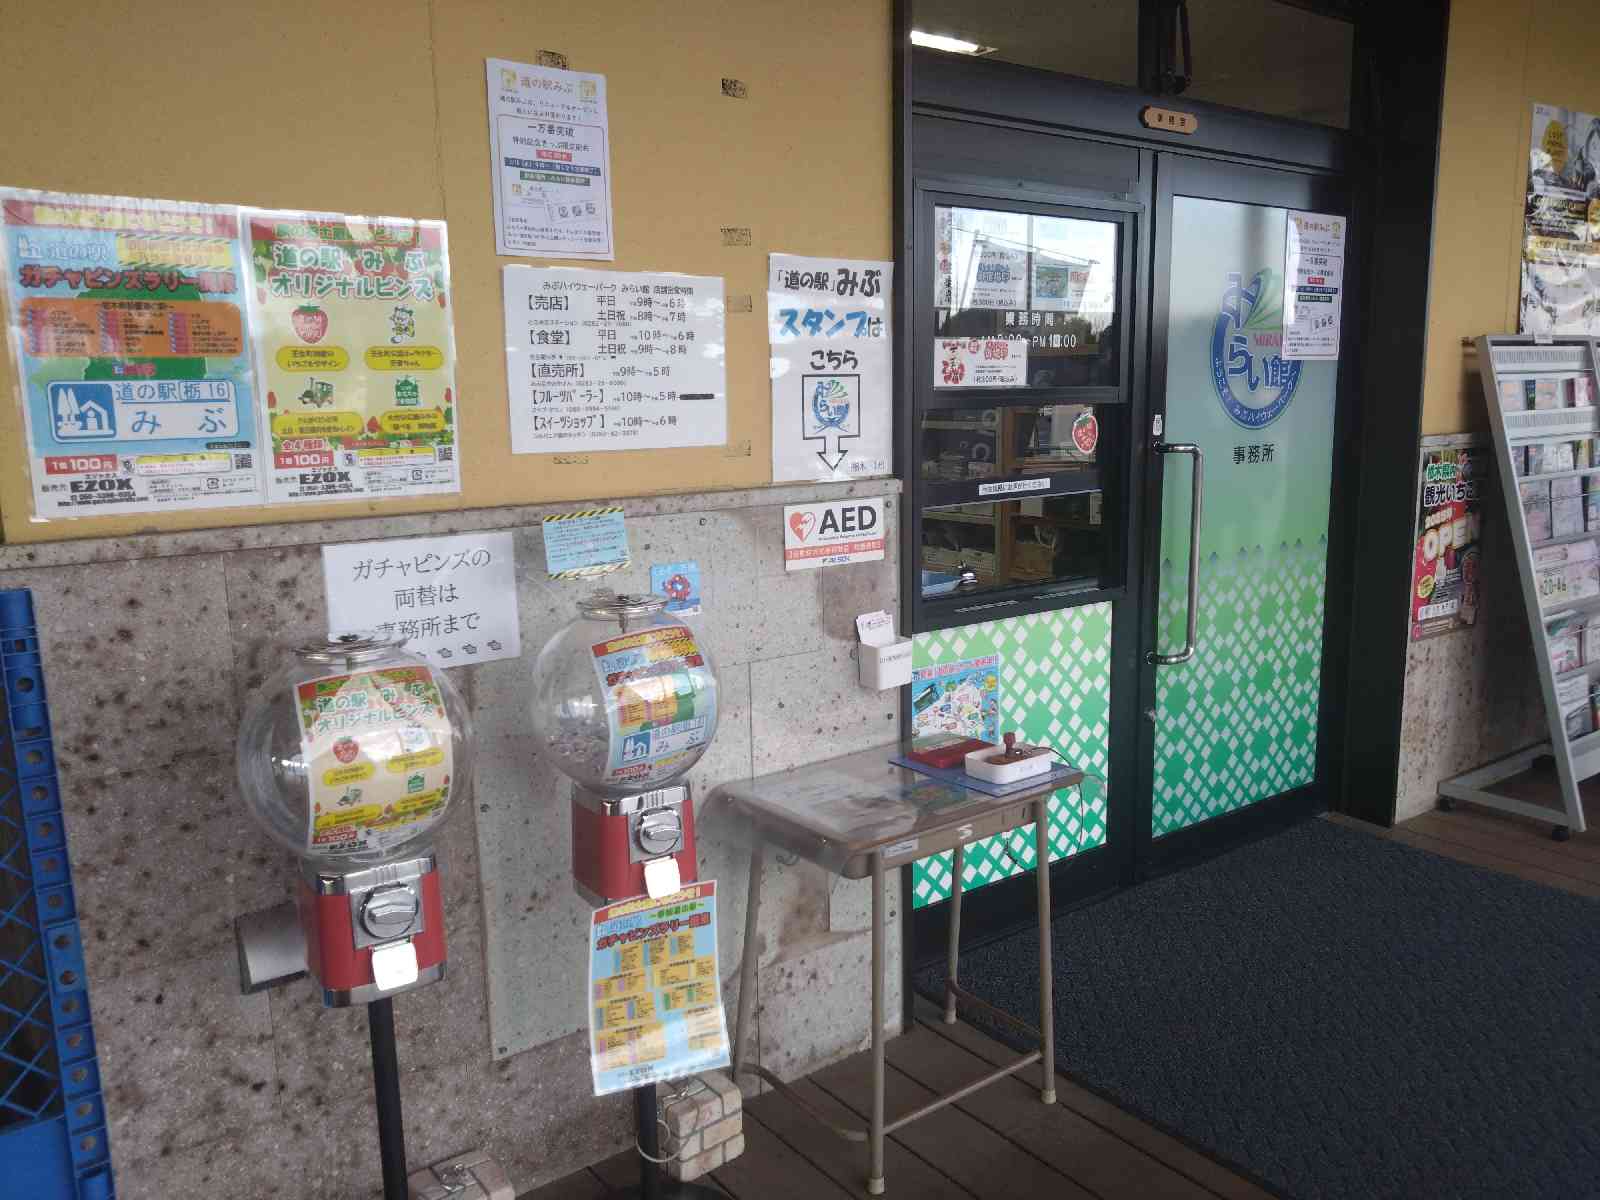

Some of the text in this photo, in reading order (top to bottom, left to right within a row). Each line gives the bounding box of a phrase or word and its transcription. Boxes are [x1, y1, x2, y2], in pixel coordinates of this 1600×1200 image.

[596, 296, 616, 307] 平日
[596, 310, 626, 321] 土日祝
[597, 330, 616, 342] 平日
[597, 343, 626, 355] 土日祝
[809, 349, 858, 370] こちら
[116, 383, 178, 401] 道の駅
[1232, 443, 1275, 464] 事務所
[818, 505, 877, 534] AED
[352, 548, 491, 581] ガチャピンズの
[393, 582, 458, 611] 両替は
